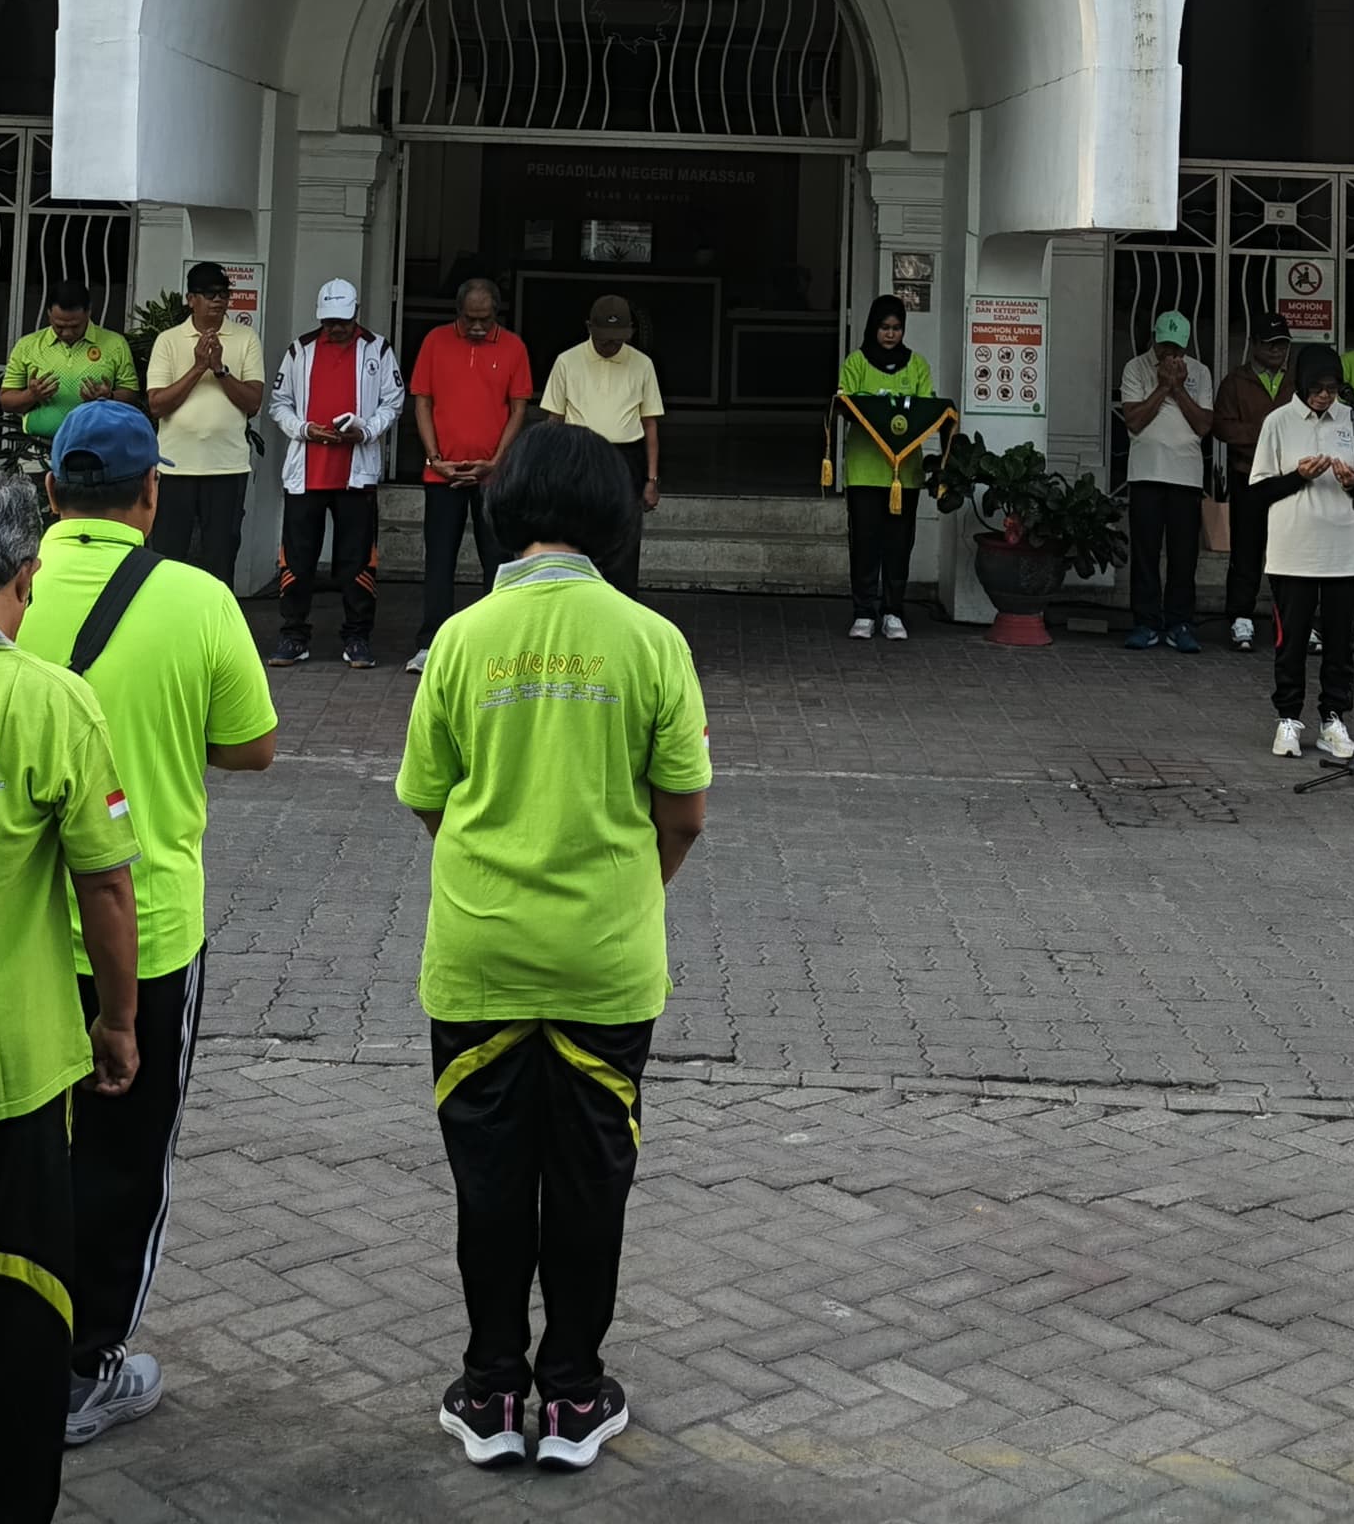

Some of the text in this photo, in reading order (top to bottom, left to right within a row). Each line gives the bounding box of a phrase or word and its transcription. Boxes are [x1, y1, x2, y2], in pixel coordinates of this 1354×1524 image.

[526, 163, 756, 184] PENGADILAN NEGERI MAKASSAR
[1289, 302, 1323, 311] MOHON
[995, 334, 1018, 342] TIDAK
[1014, 327, 1041, 335] UNTUK
[273, 372, 285, 390] 9
[392, 369, 403, 388] 8
[487, 651, 543, 682] Kulle
